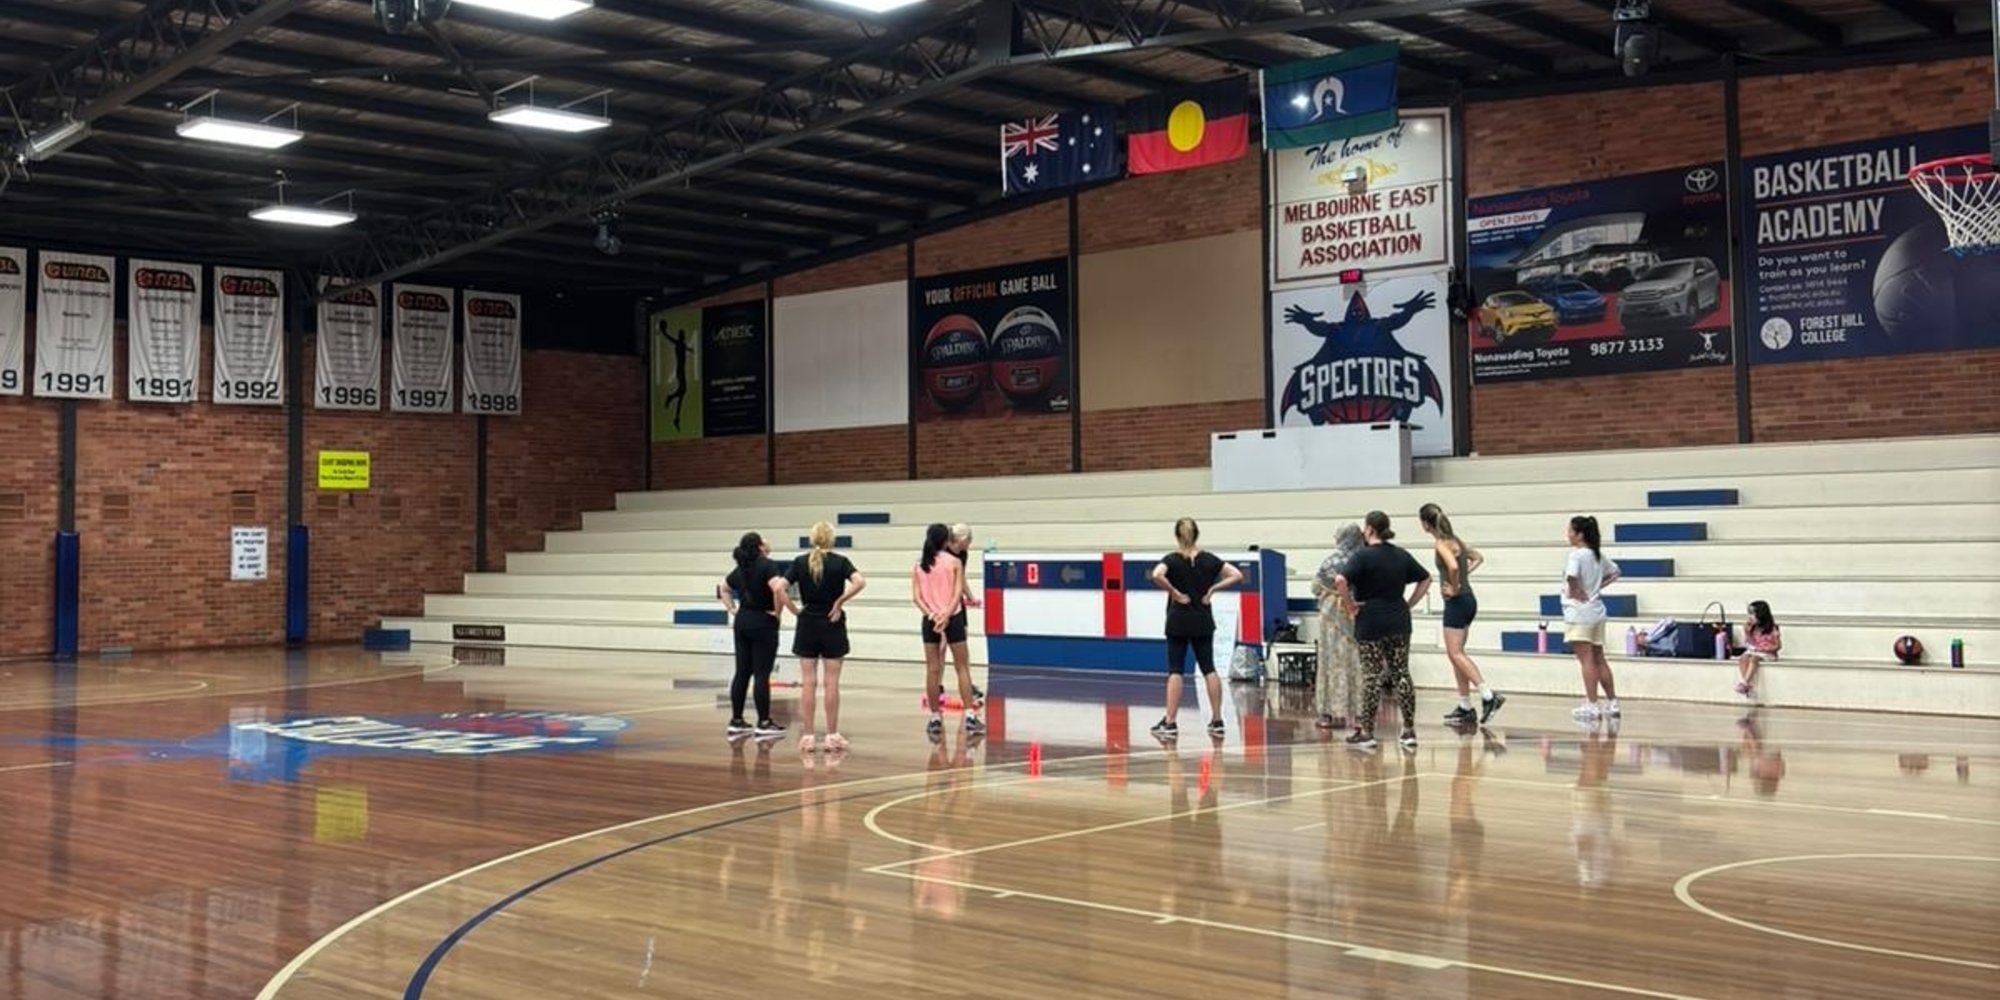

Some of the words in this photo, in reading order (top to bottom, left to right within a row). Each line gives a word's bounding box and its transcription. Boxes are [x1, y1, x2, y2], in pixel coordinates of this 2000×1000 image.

[1306, 142, 1335, 171] The
[1341, 138, 1380, 158] home
[1387, 122, 1406, 148] of
[1284, 193, 1382, 224] MELBOURNE
[1389, 184, 1439, 206] EAST
[1301, 212, 1417, 244] BASKETBALL
[1480, 218, 1505, 228] OPEN
[1513, 214, 1538, 223] DAYS
[1757, 197, 1885, 244] ACADEMY
[1300, 233, 1422, 267] ASSOCIATION
[1758, 256, 1774, 267] Do
[1776, 256, 1798, 269] you
[1801, 251, 1830, 262] want
[1834, 250, 1847, 258] to
[1760, 268, 1787, 280] train
[1790, 268, 1802, 276] as
[1805, 266, 1827, 278] you
[1830, 259, 1866, 272] learn?
[925, 289, 951, 306] YOUR
[953, 282, 998, 302] OFFICIAL
[1000, 278, 1028, 296] GAME
[1032, 274, 1057, 292] BALL
[1800, 314, 1838, 330] FOREST
[1841, 313, 1865, 328] HILL
[1801, 328, 1846, 344] COLLEGE
[1474, 350, 1534, 363] Nunawading
[1536, 347, 1570, 360] Toyota
[1590, 341, 1625, 356] 9877
[1628, 338, 1664, 352] 3133
[41, 372, 105, 394] 1991
[136, 377, 192, 398] 1991
[221, 380, 280, 399] 1992
[1300, 356, 1420, 410] SPECTRES
[321, 386, 377, 406] 1996
[398, 390, 448, 408] 1997
[468, 392, 518, 412] 1998
[1028, 563, 1039, 584] 0
